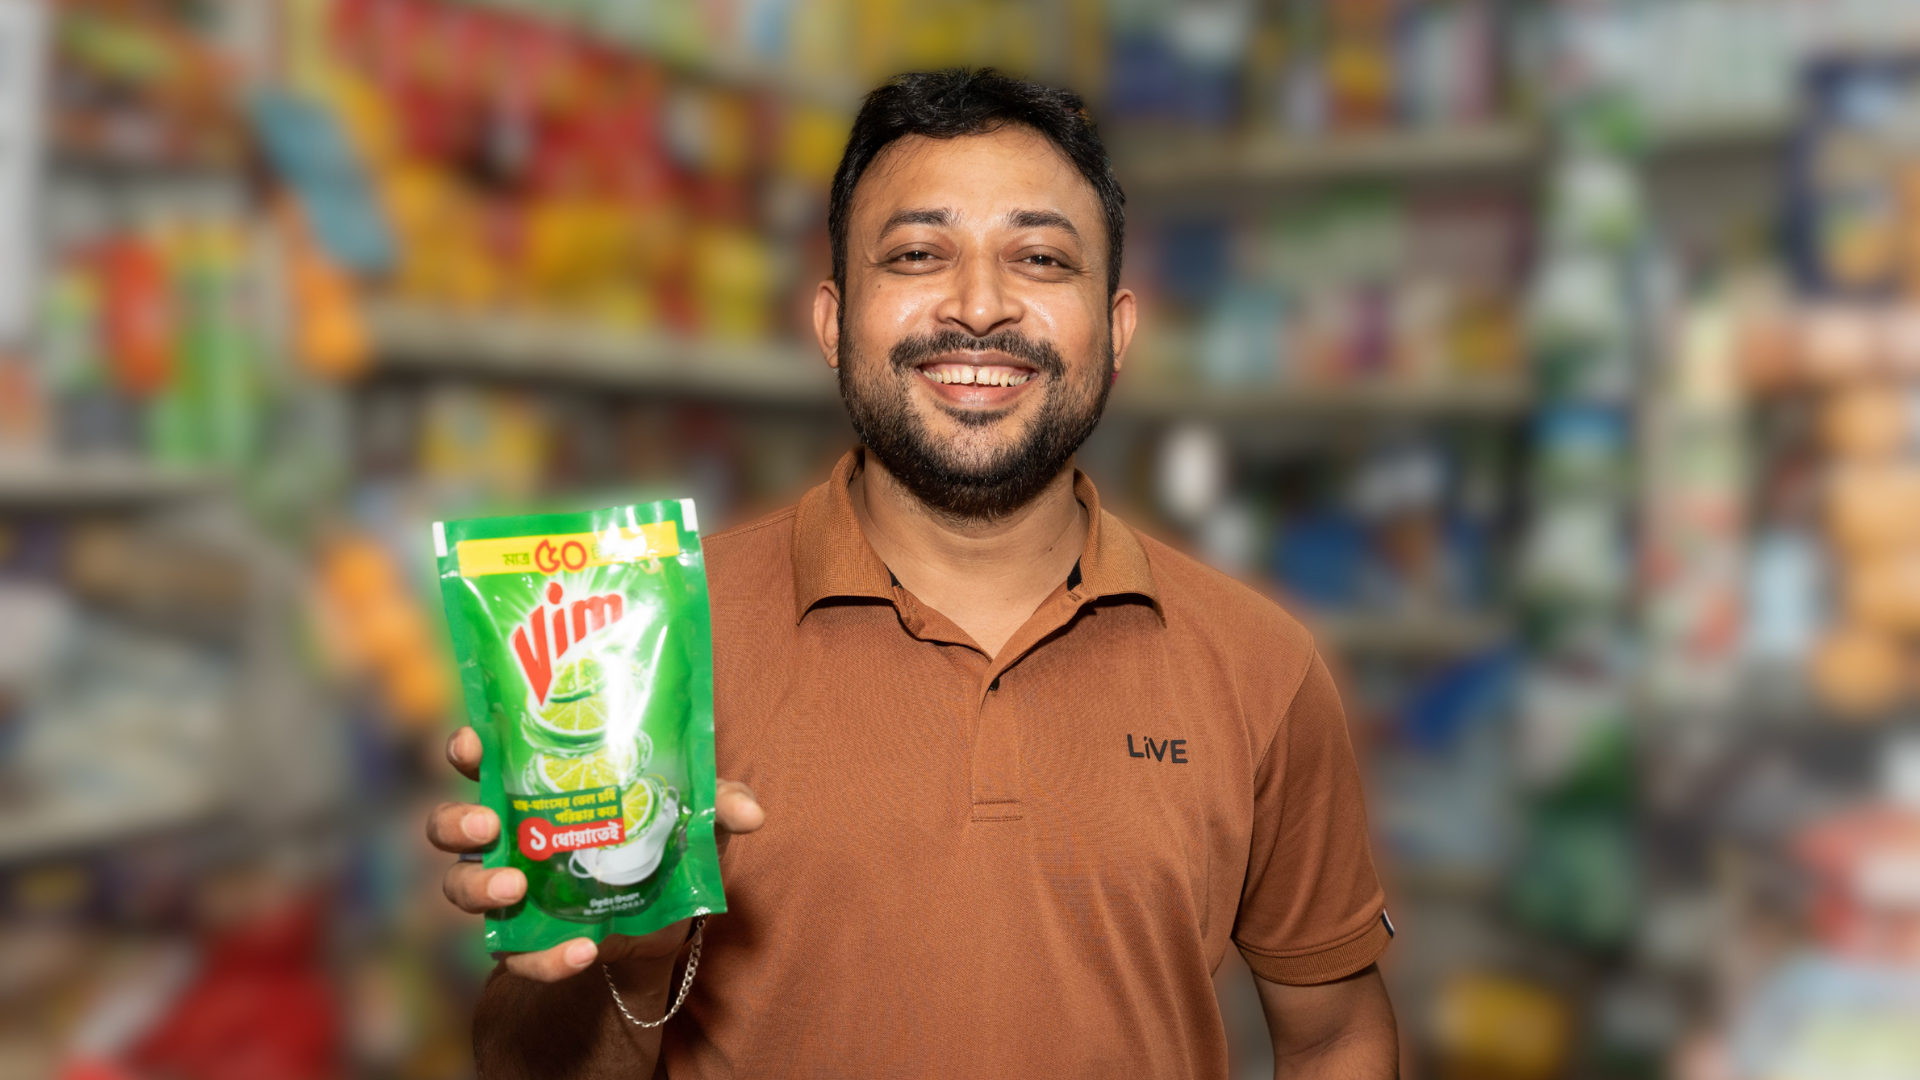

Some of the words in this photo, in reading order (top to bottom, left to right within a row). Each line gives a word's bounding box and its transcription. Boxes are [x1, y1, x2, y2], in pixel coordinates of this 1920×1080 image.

[502, 552, 530, 567] মাত্র
[535, 539, 587, 573] ৫০
[511, 581, 622, 707] Vim
[572, 794, 596, 807] তেল
[597, 805, 618, 818] করে
[530, 826, 547, 851] ১
[552, 821, 621, 848] ধোয়াতেই
